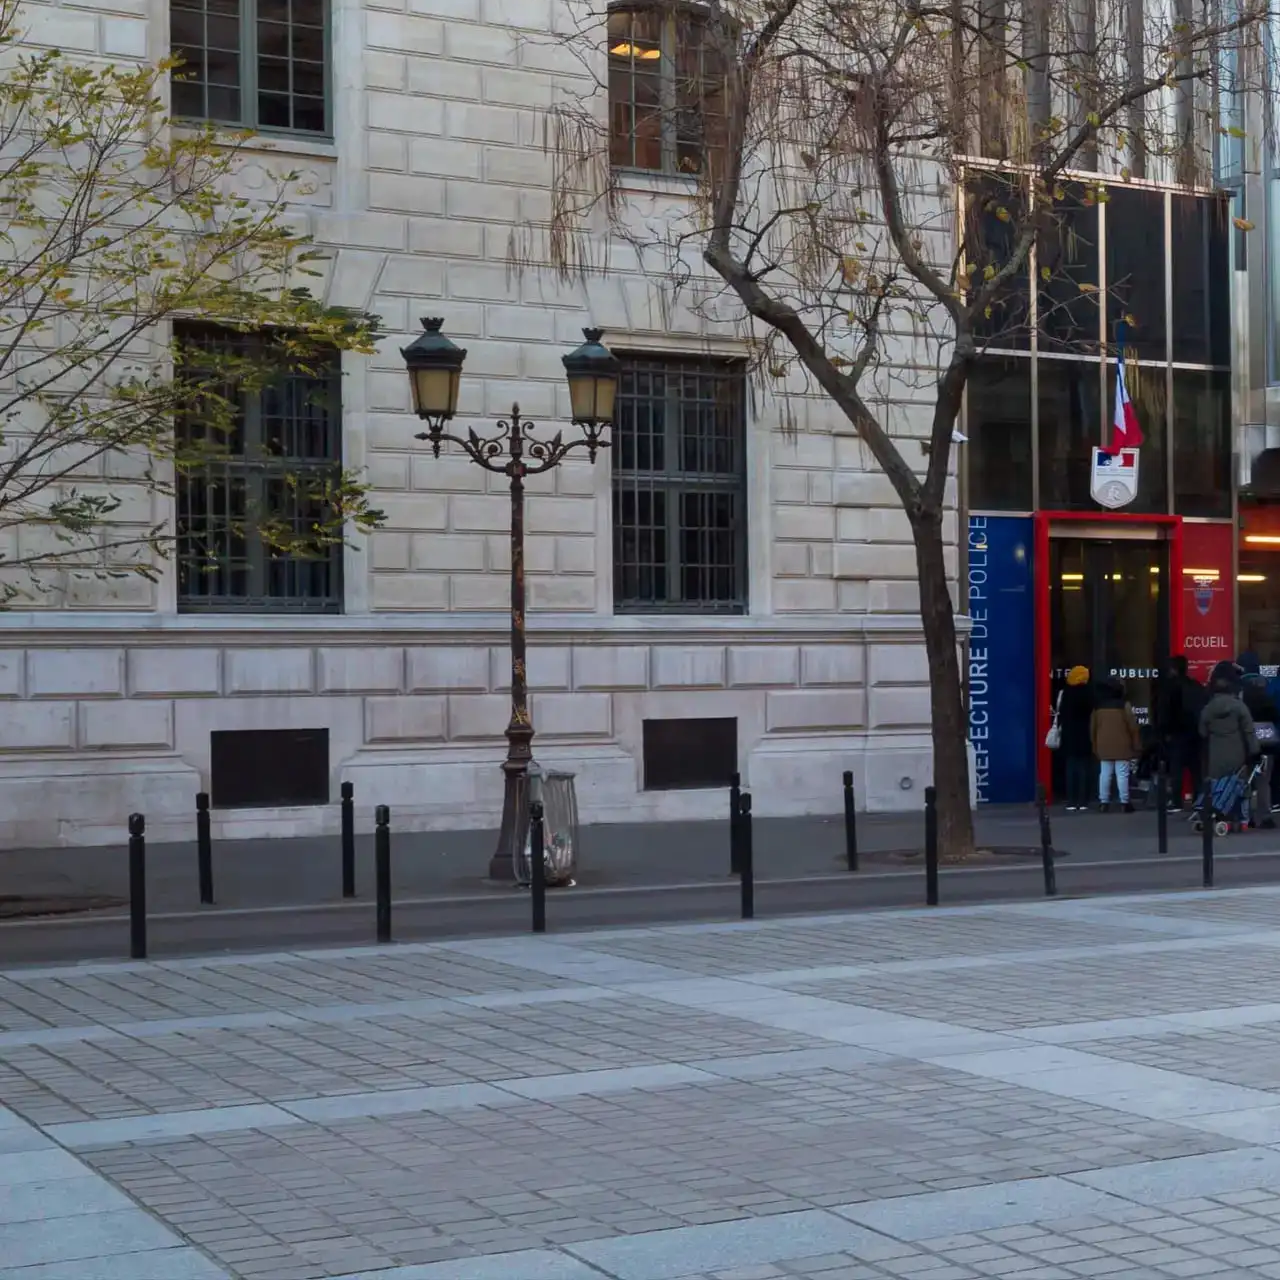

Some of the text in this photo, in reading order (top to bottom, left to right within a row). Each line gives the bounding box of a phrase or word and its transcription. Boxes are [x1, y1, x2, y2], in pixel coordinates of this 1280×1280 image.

[968, 517, 988, 599] POLICE
[969, 608, 988, 638] DE
[1183, 636, 1229, 648] CCUEIL
[1110, 668, 1159, 678] PUBLIC
